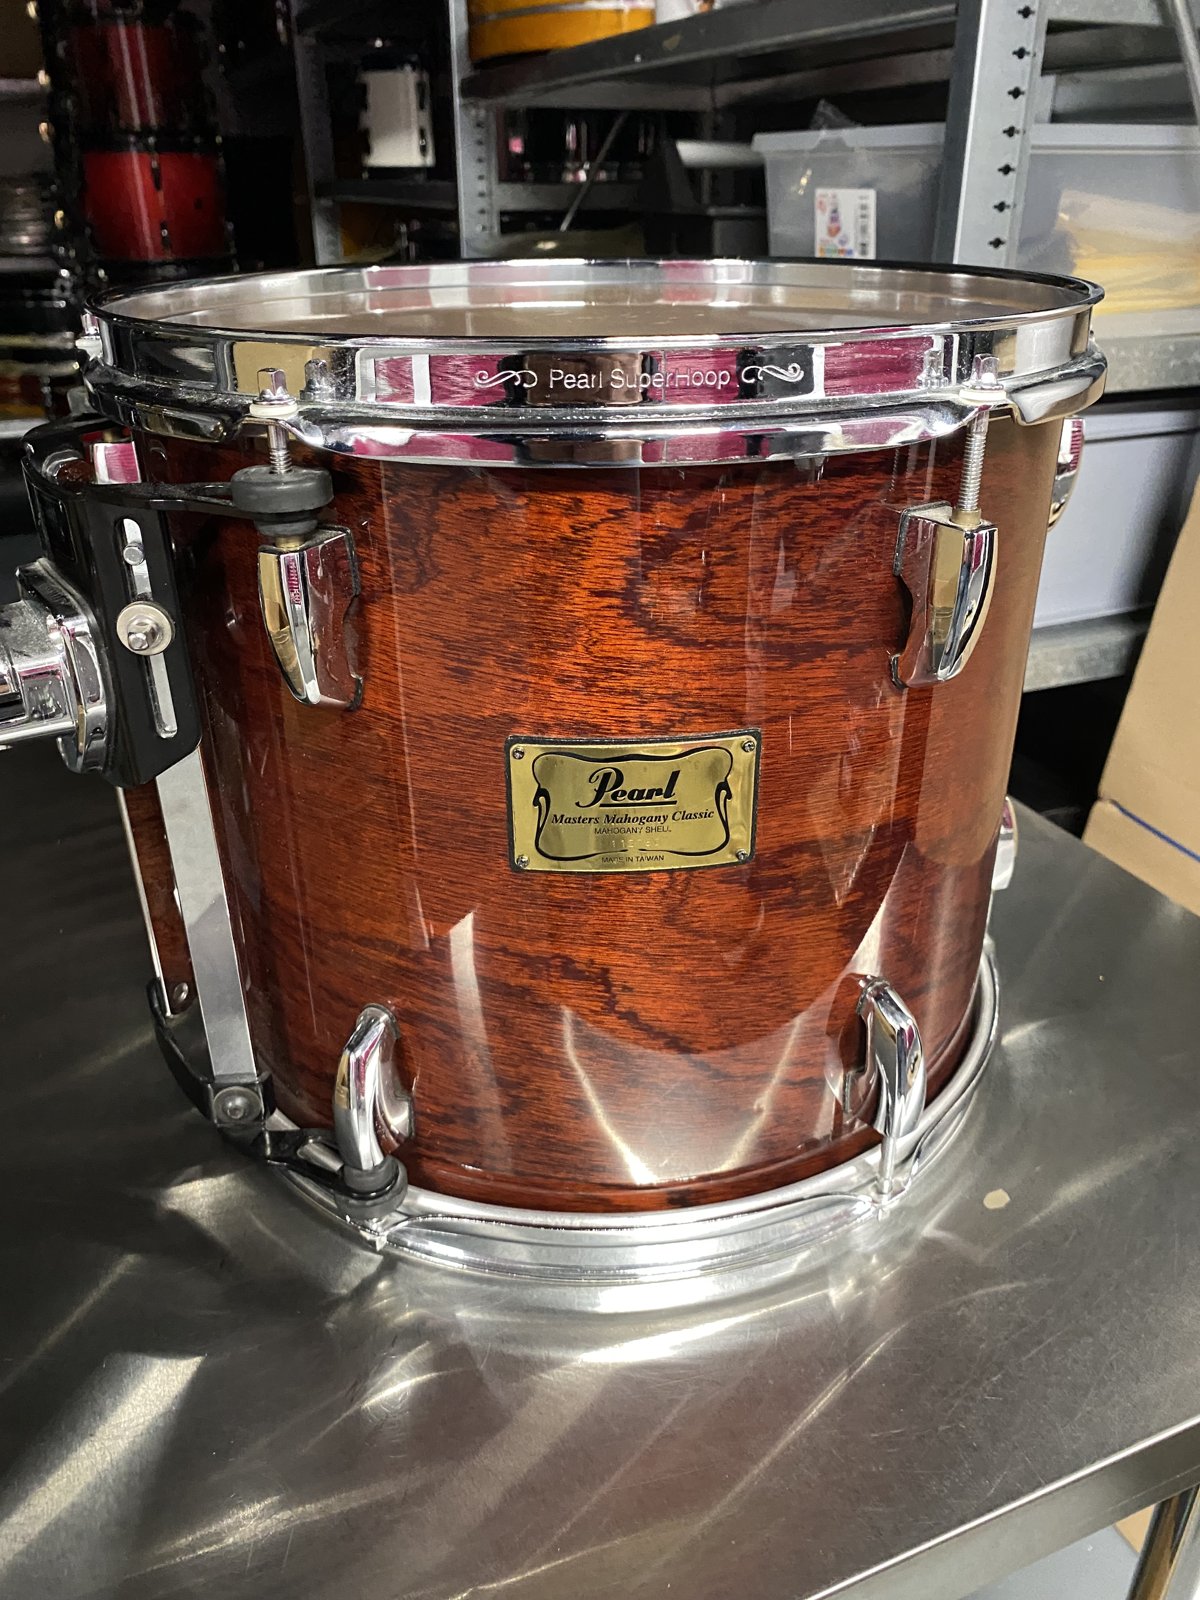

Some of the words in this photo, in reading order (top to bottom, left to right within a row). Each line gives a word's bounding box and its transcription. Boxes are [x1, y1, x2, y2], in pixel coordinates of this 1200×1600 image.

[549, 370, 602, 389] Pearl
[610, 369, 731, 391] SuperHoop
[575, 767, 681, 808] Pearl
[551, 813, 600, 826] Masters
[603, 812, 669, 826] Mahogany
[671, 808, 715, 822] Classic
[594, 827, 643, 835] MAHOGANY
[645, 825, 672, 834] SHELL
[635, 854, 665, 862] TAIWAN
